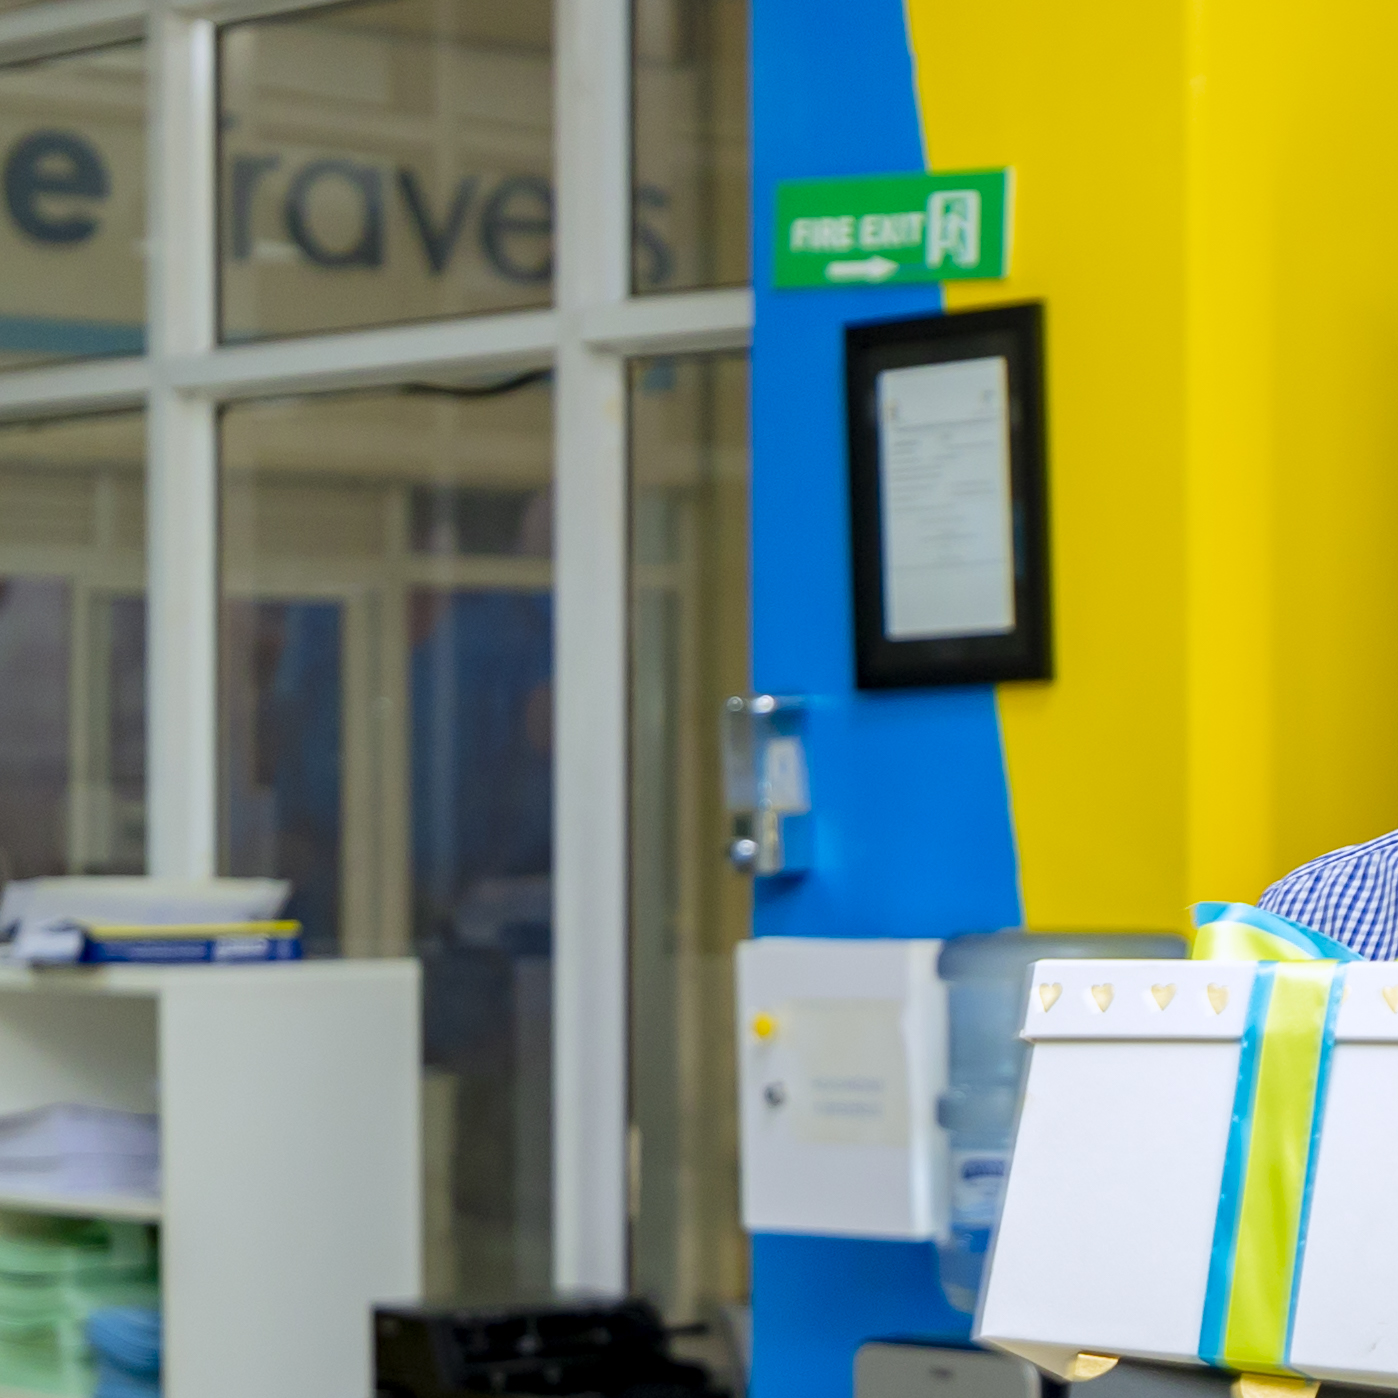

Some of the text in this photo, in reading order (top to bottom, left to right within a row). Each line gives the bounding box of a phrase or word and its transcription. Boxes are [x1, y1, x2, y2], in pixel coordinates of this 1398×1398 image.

[217, 108, 674, 288] raves
[790, 211, 923, 252] FIRE EXIT
